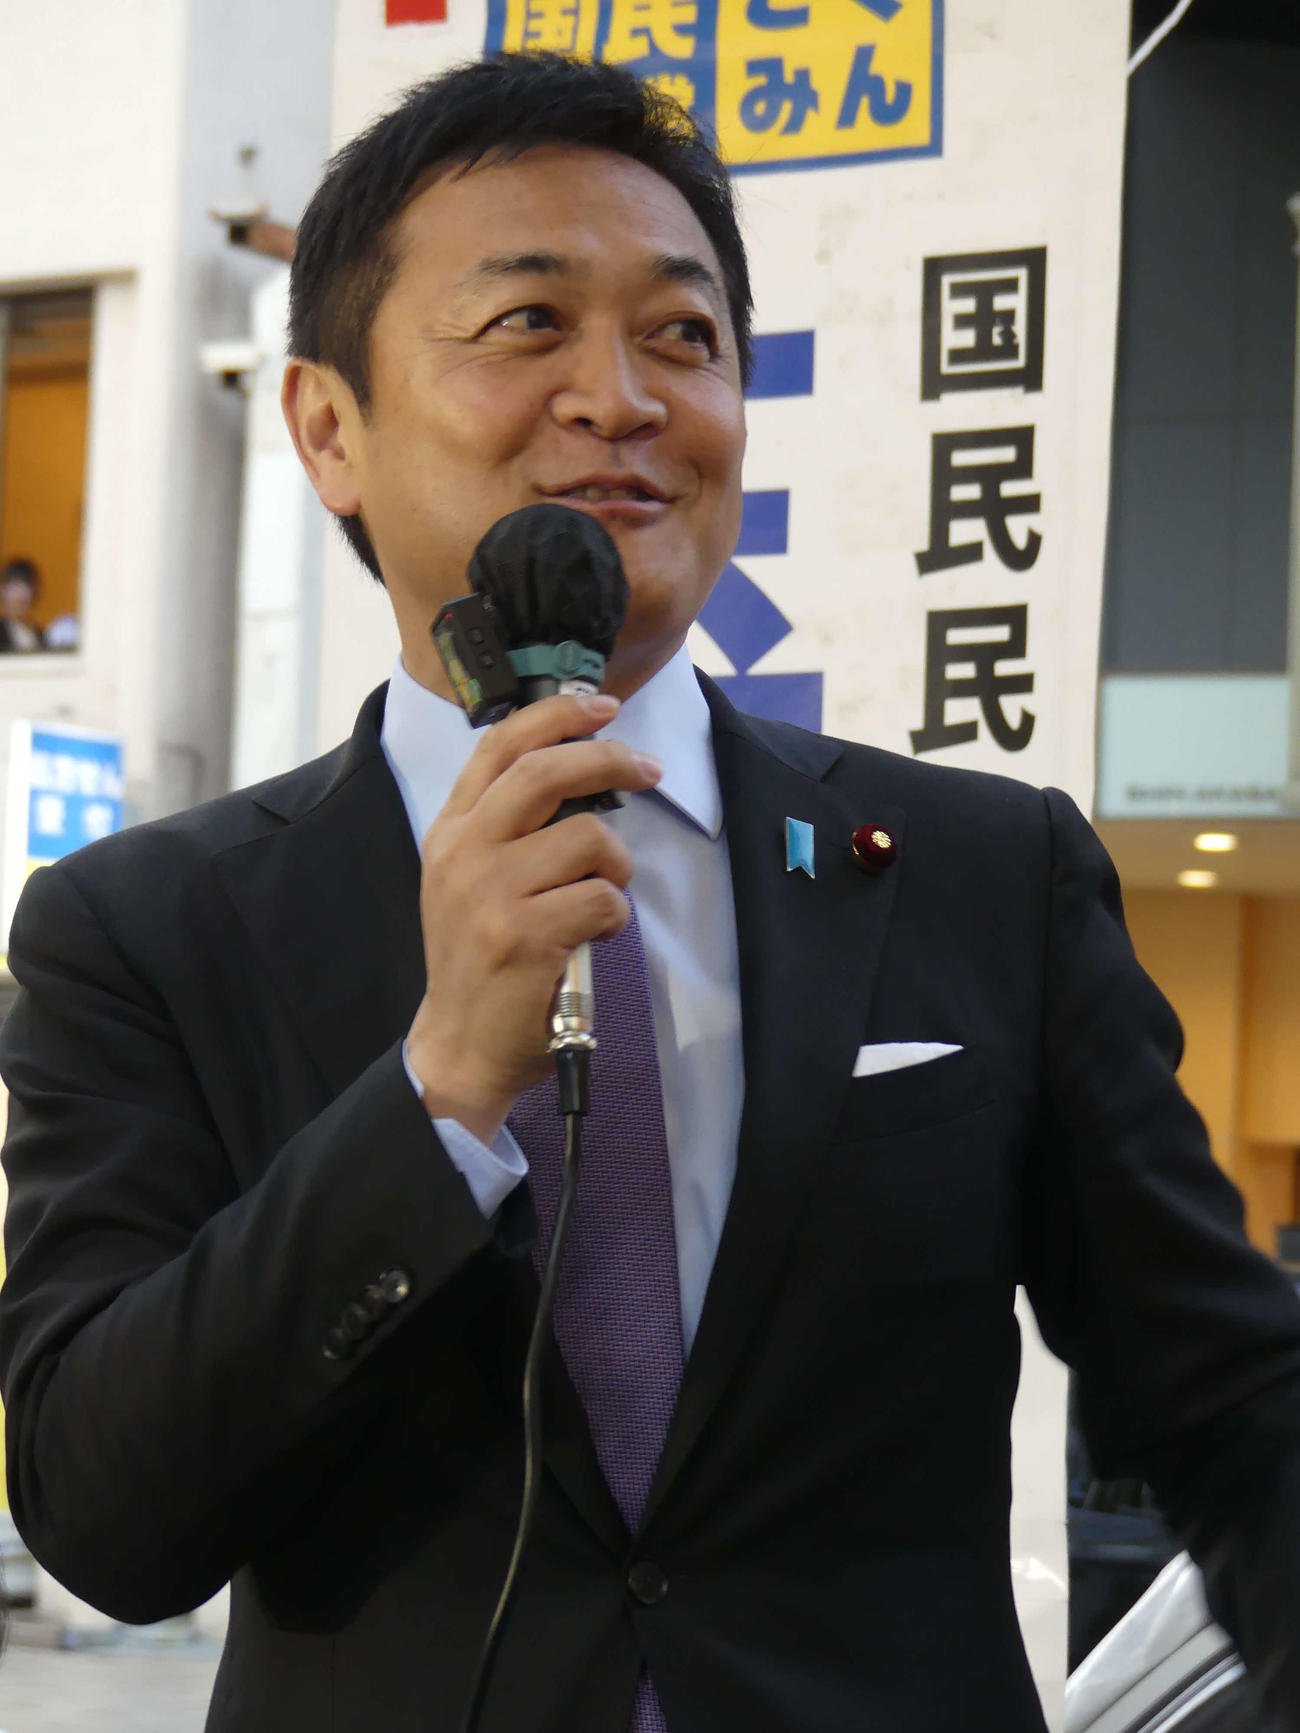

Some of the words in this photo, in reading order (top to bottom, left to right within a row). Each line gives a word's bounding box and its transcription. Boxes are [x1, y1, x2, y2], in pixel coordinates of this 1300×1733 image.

[739, 43, 912, 137] みん
[908, 245, 1047, 755] 国民民
